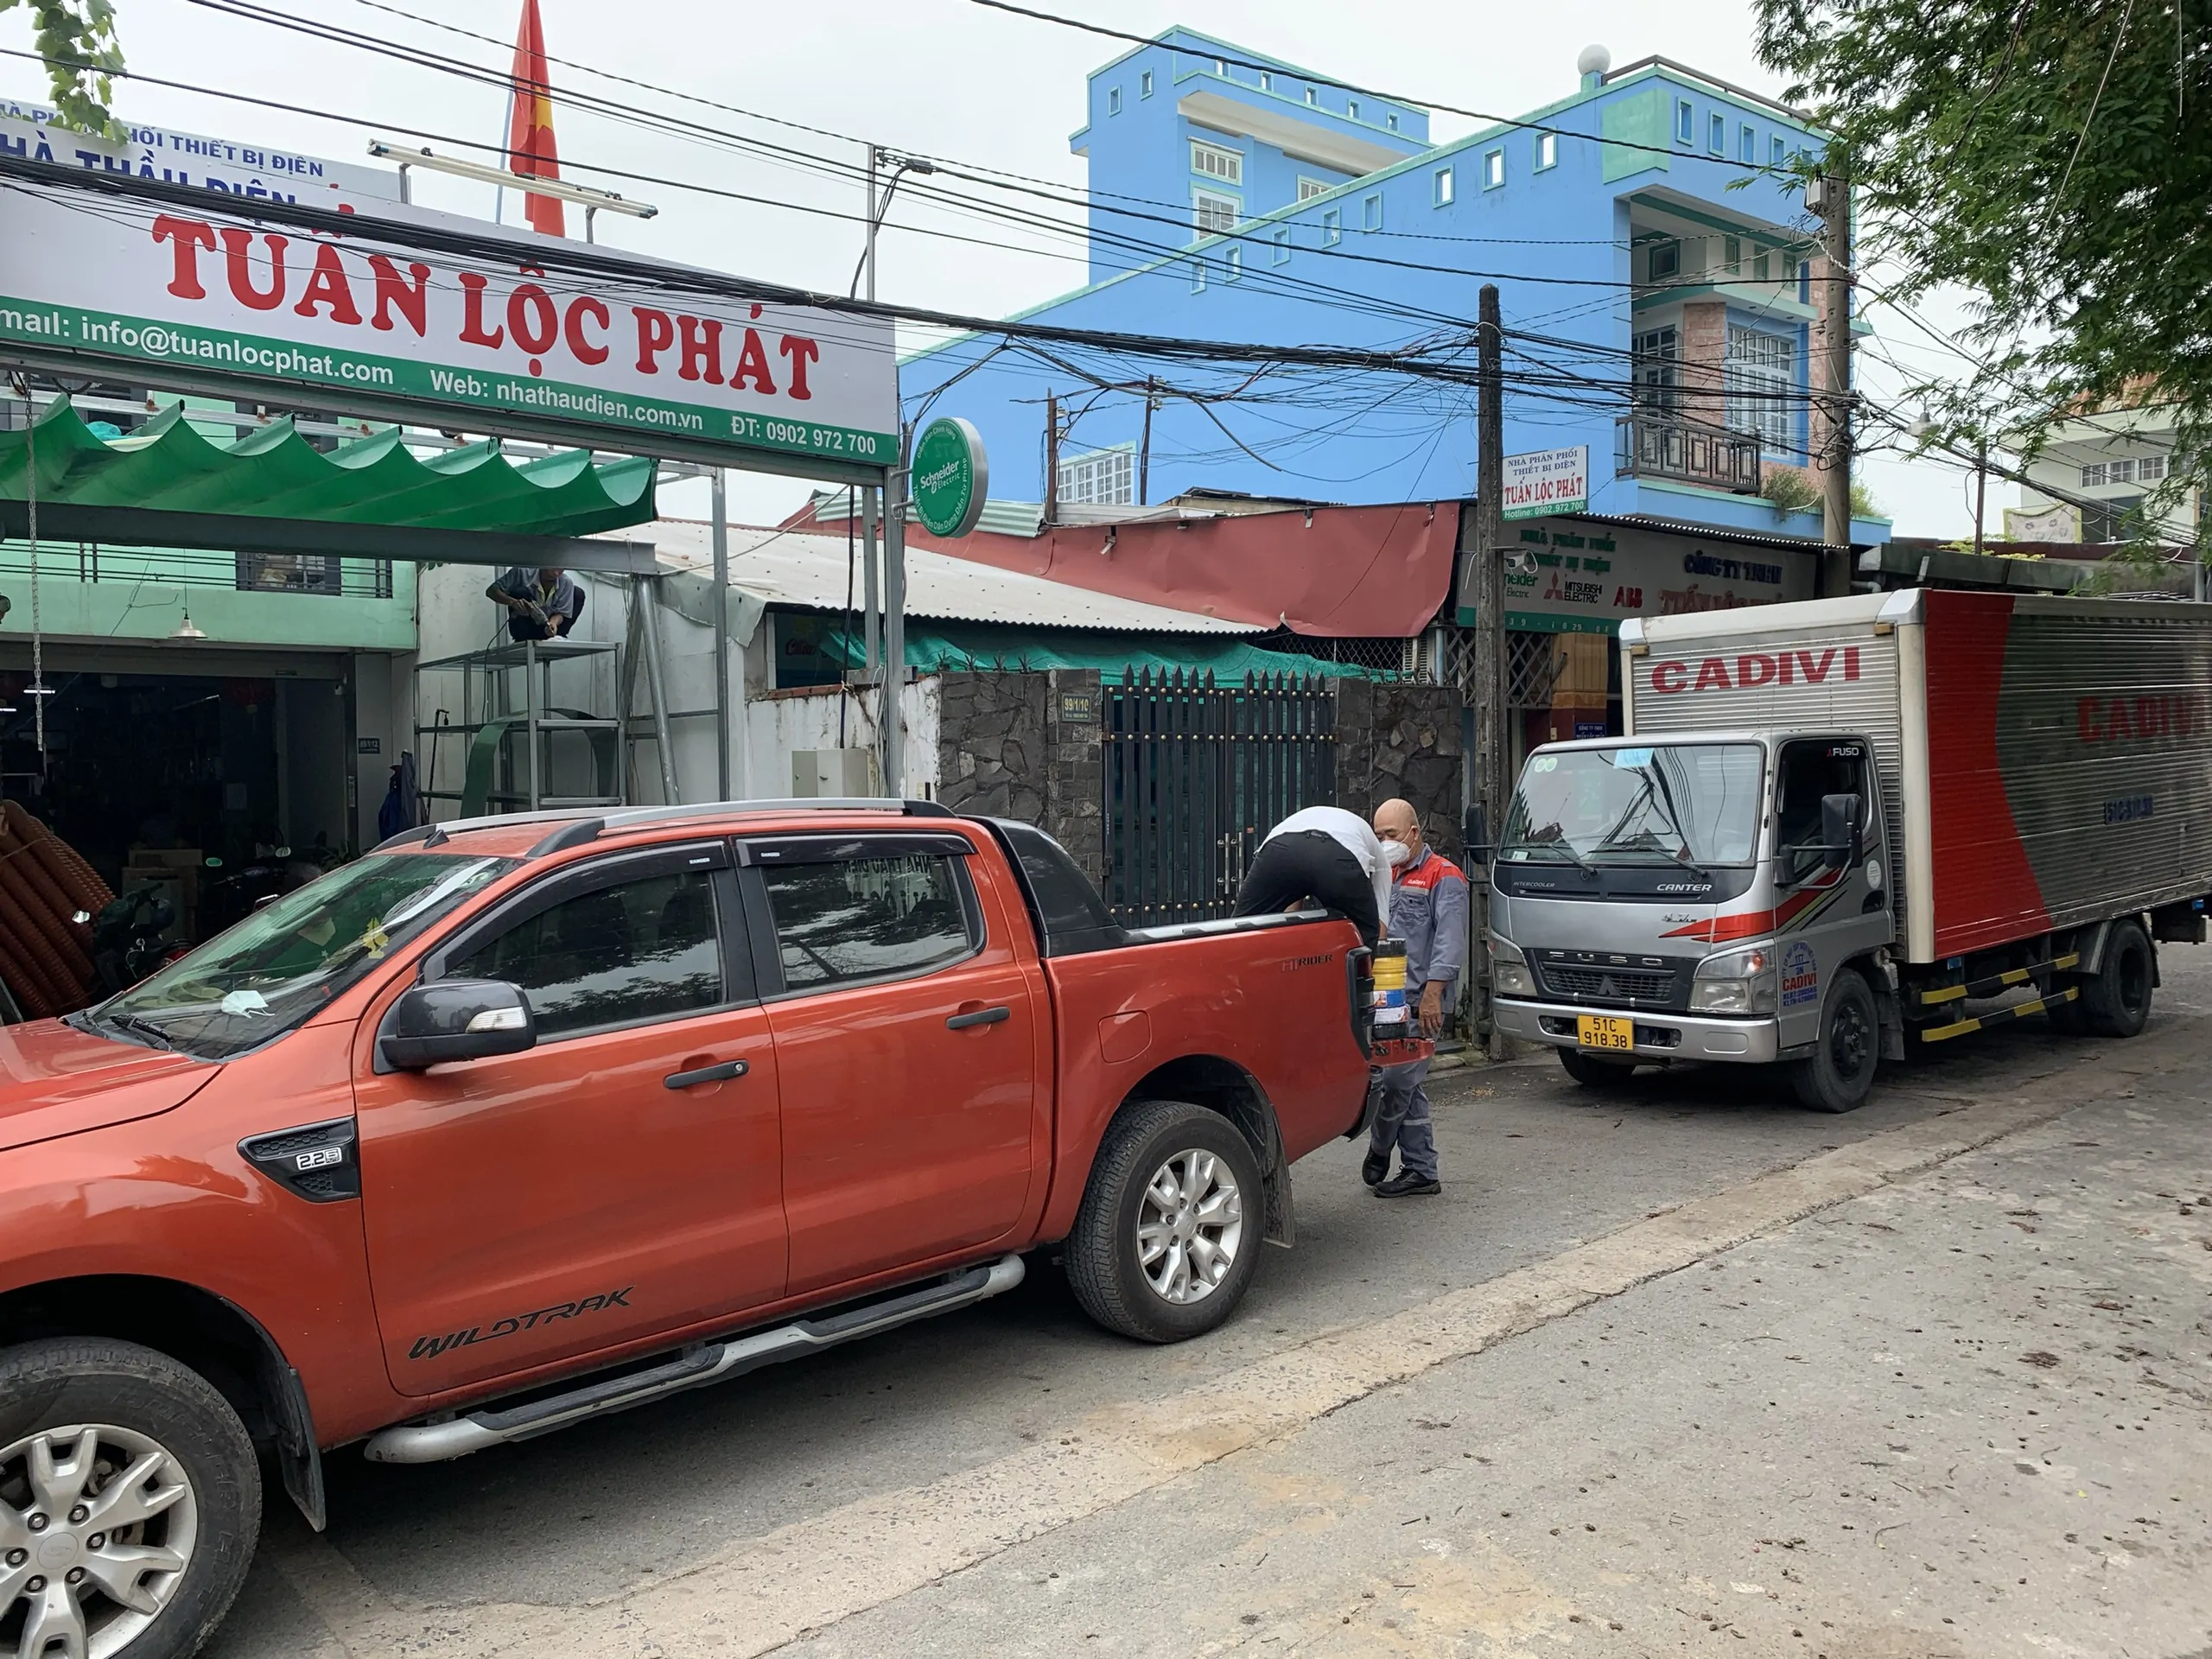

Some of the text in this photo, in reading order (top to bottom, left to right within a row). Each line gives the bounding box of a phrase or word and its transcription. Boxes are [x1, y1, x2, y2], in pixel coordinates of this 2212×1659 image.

[126, 126, 163, 147] HỐI
[169, 135, 237, 161] THIẾT
[242, 149, 264, 169] BỊ
[151, 203, 820, 401] TUẤN LỘC PHÁT
[81, 315, 394, 385] info@tuanlocphat.com
[429, 369, 489, 398] Web:
[496, 380, 703, 430] nhathaudien.com.vn
[730, 416, 761, 438] ĐT:
[766, 421, 807, 446] 0902
[813, 425, 843, 450] 972
[847, 433, 877, 455] 700
[1507, 448, 1578, 467] NHÀ PHÂN PHỐI
[920, 459, 960, 490] Schneider
[1512, 460, 1577, 476] THIẾT BỊ ĐIỆN
[938, 472, 961, 490] Electric
[1504, 472, 1583, 505] TUẤN LỘC PHÁT
[1504, 508, 1534, 519] Hotline:
[1572, 500, 1585, 511] 700
[1504, 571, 1539, 588] neider
[1564, 581, 1603, 595] MITSUBISHI
[1564, 592, 1599, 605] ELECTRIC
[1612, 585, 1643, 609] ABB
[1651, 645, 1860, 694] CADIVI
[1832, 747, 1859, 757] FUSO
[1513, 880, 1555, 888] INTERCOOLER
[1656, 882, 1713, 892] CANTER
[1548, 950, 1663, 967] FUSO
[1783, 973, 1817, 992] CADIVI
[1592, 1017, 1618, 1033] 51C
[1584, 1031, 1628, 1048] 918.38
[299, 1152, 326, 1168] 2.2
[408, 1284, 636, 1361] WILDTRAK
